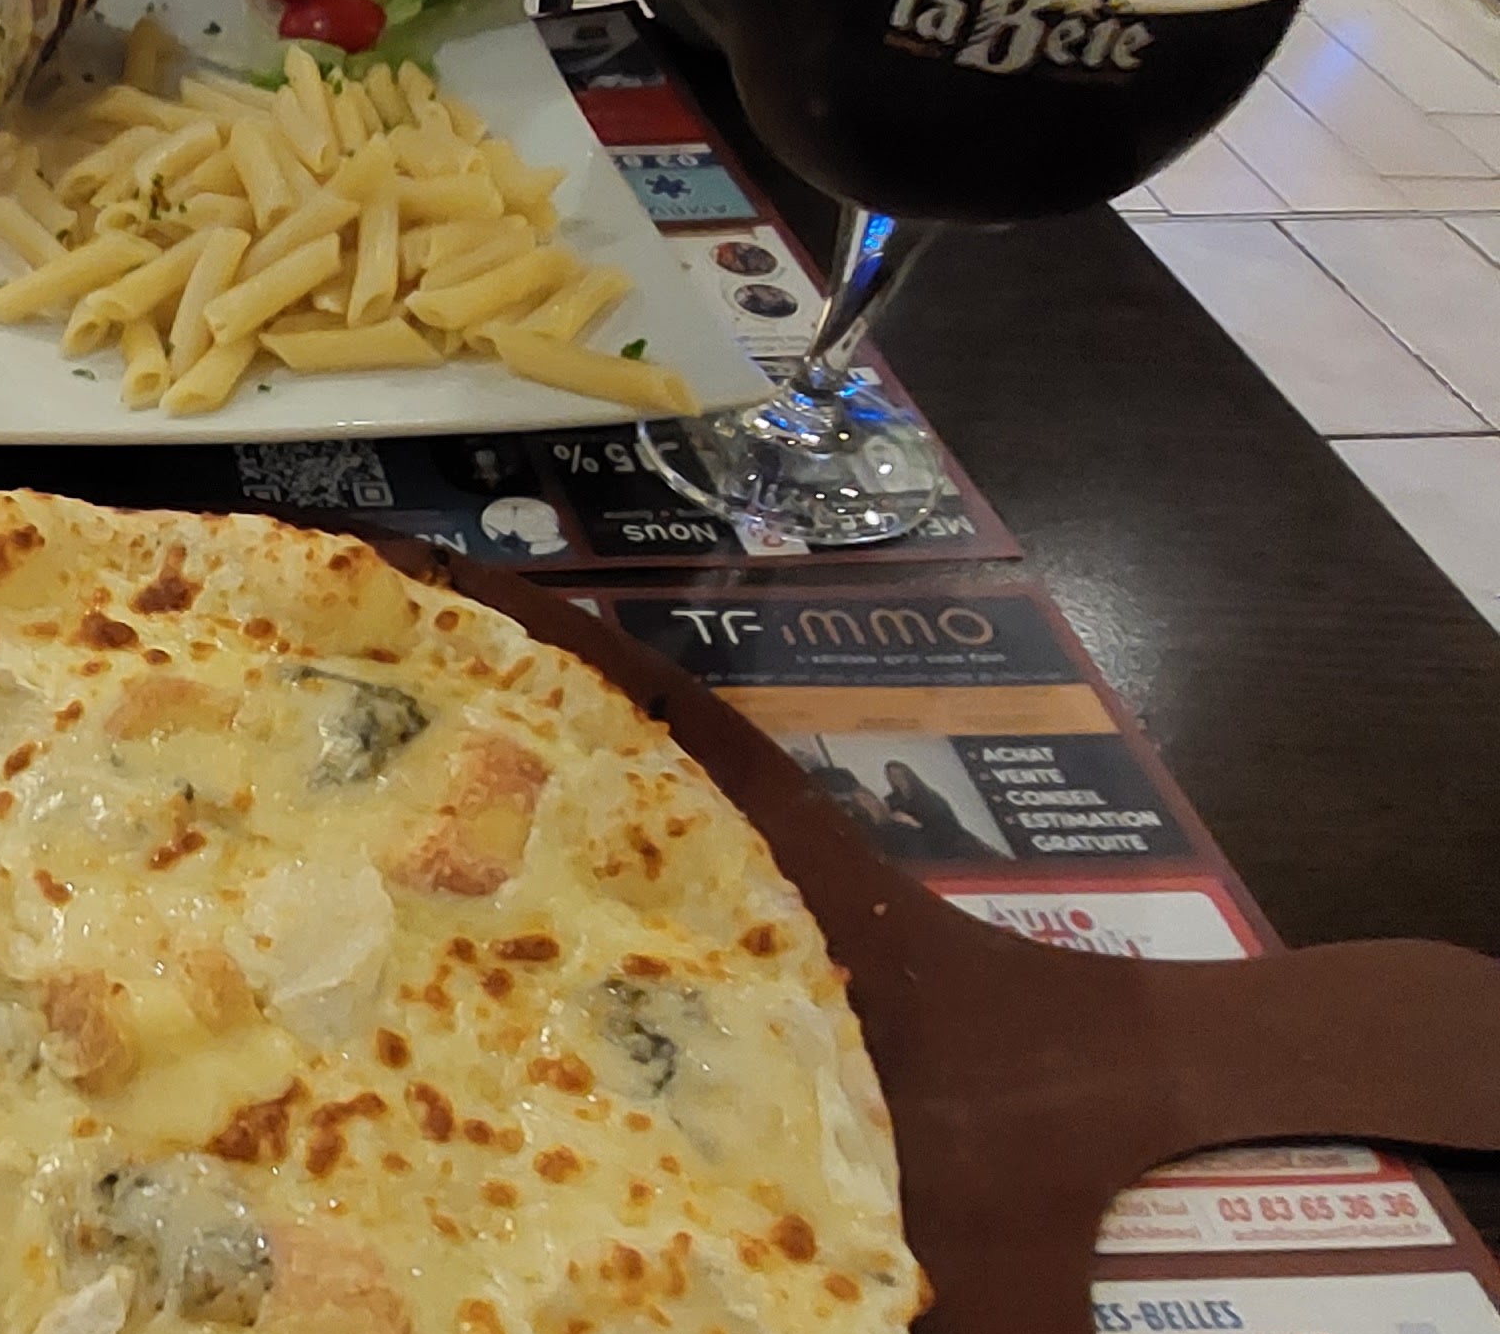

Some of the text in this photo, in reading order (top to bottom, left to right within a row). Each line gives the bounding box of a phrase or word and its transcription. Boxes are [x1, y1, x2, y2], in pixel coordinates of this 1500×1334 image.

[622, 521, 718, 544] NOUS
[671, 609, 764, 645] TF
[982, 746, 1055, 763] ACHAT
[990, 767, 1067, 784] VENTE
[1004, 789, 1108, 806] CONSEIL
[1016, 810, 1163, 829] ESTIMATION
[1031, 833, 1149, 852] GRATUITE
[1094, 1299, 1244, 1332] ES-BELLES
